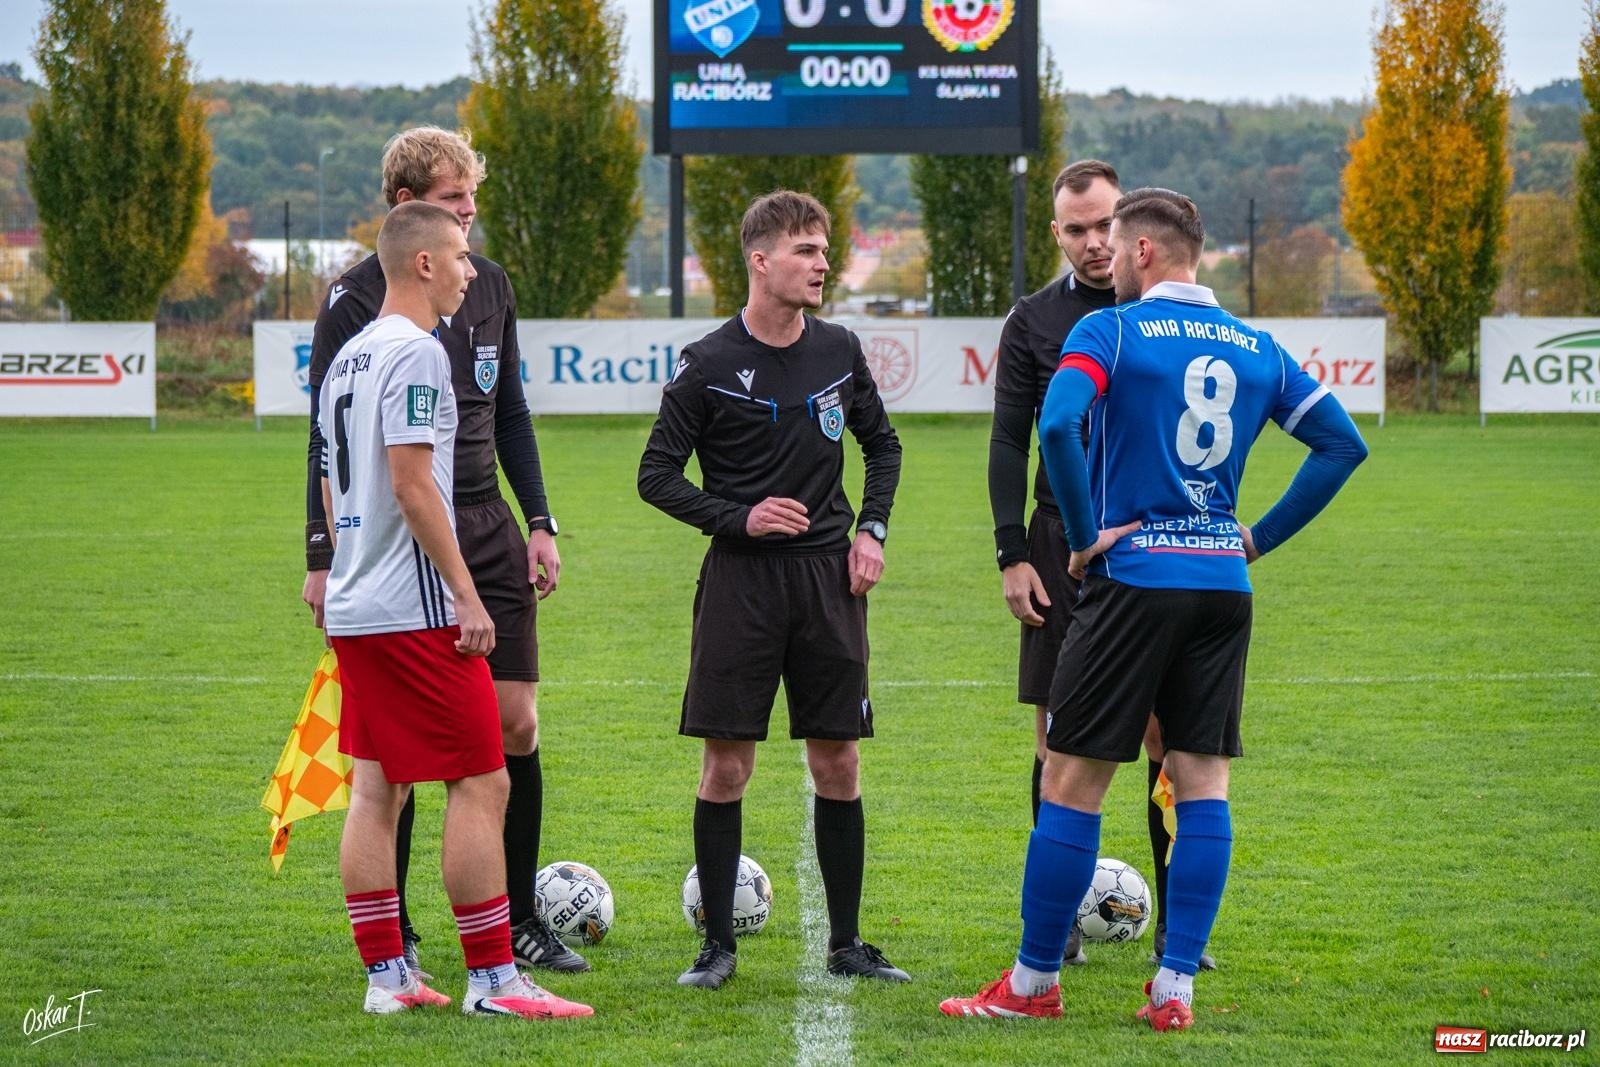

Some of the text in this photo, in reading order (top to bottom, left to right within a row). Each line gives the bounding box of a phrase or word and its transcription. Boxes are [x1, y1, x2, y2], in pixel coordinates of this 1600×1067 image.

[800, 56, 891, 88] 00:00
[1138, 319, 1261, 354] UNIA RACIBÓRZ
[1502, 353, 1600, 385] AGR
[1175, 355, 1238, 471] 8
[552, 885, 596, 931] SELECT
